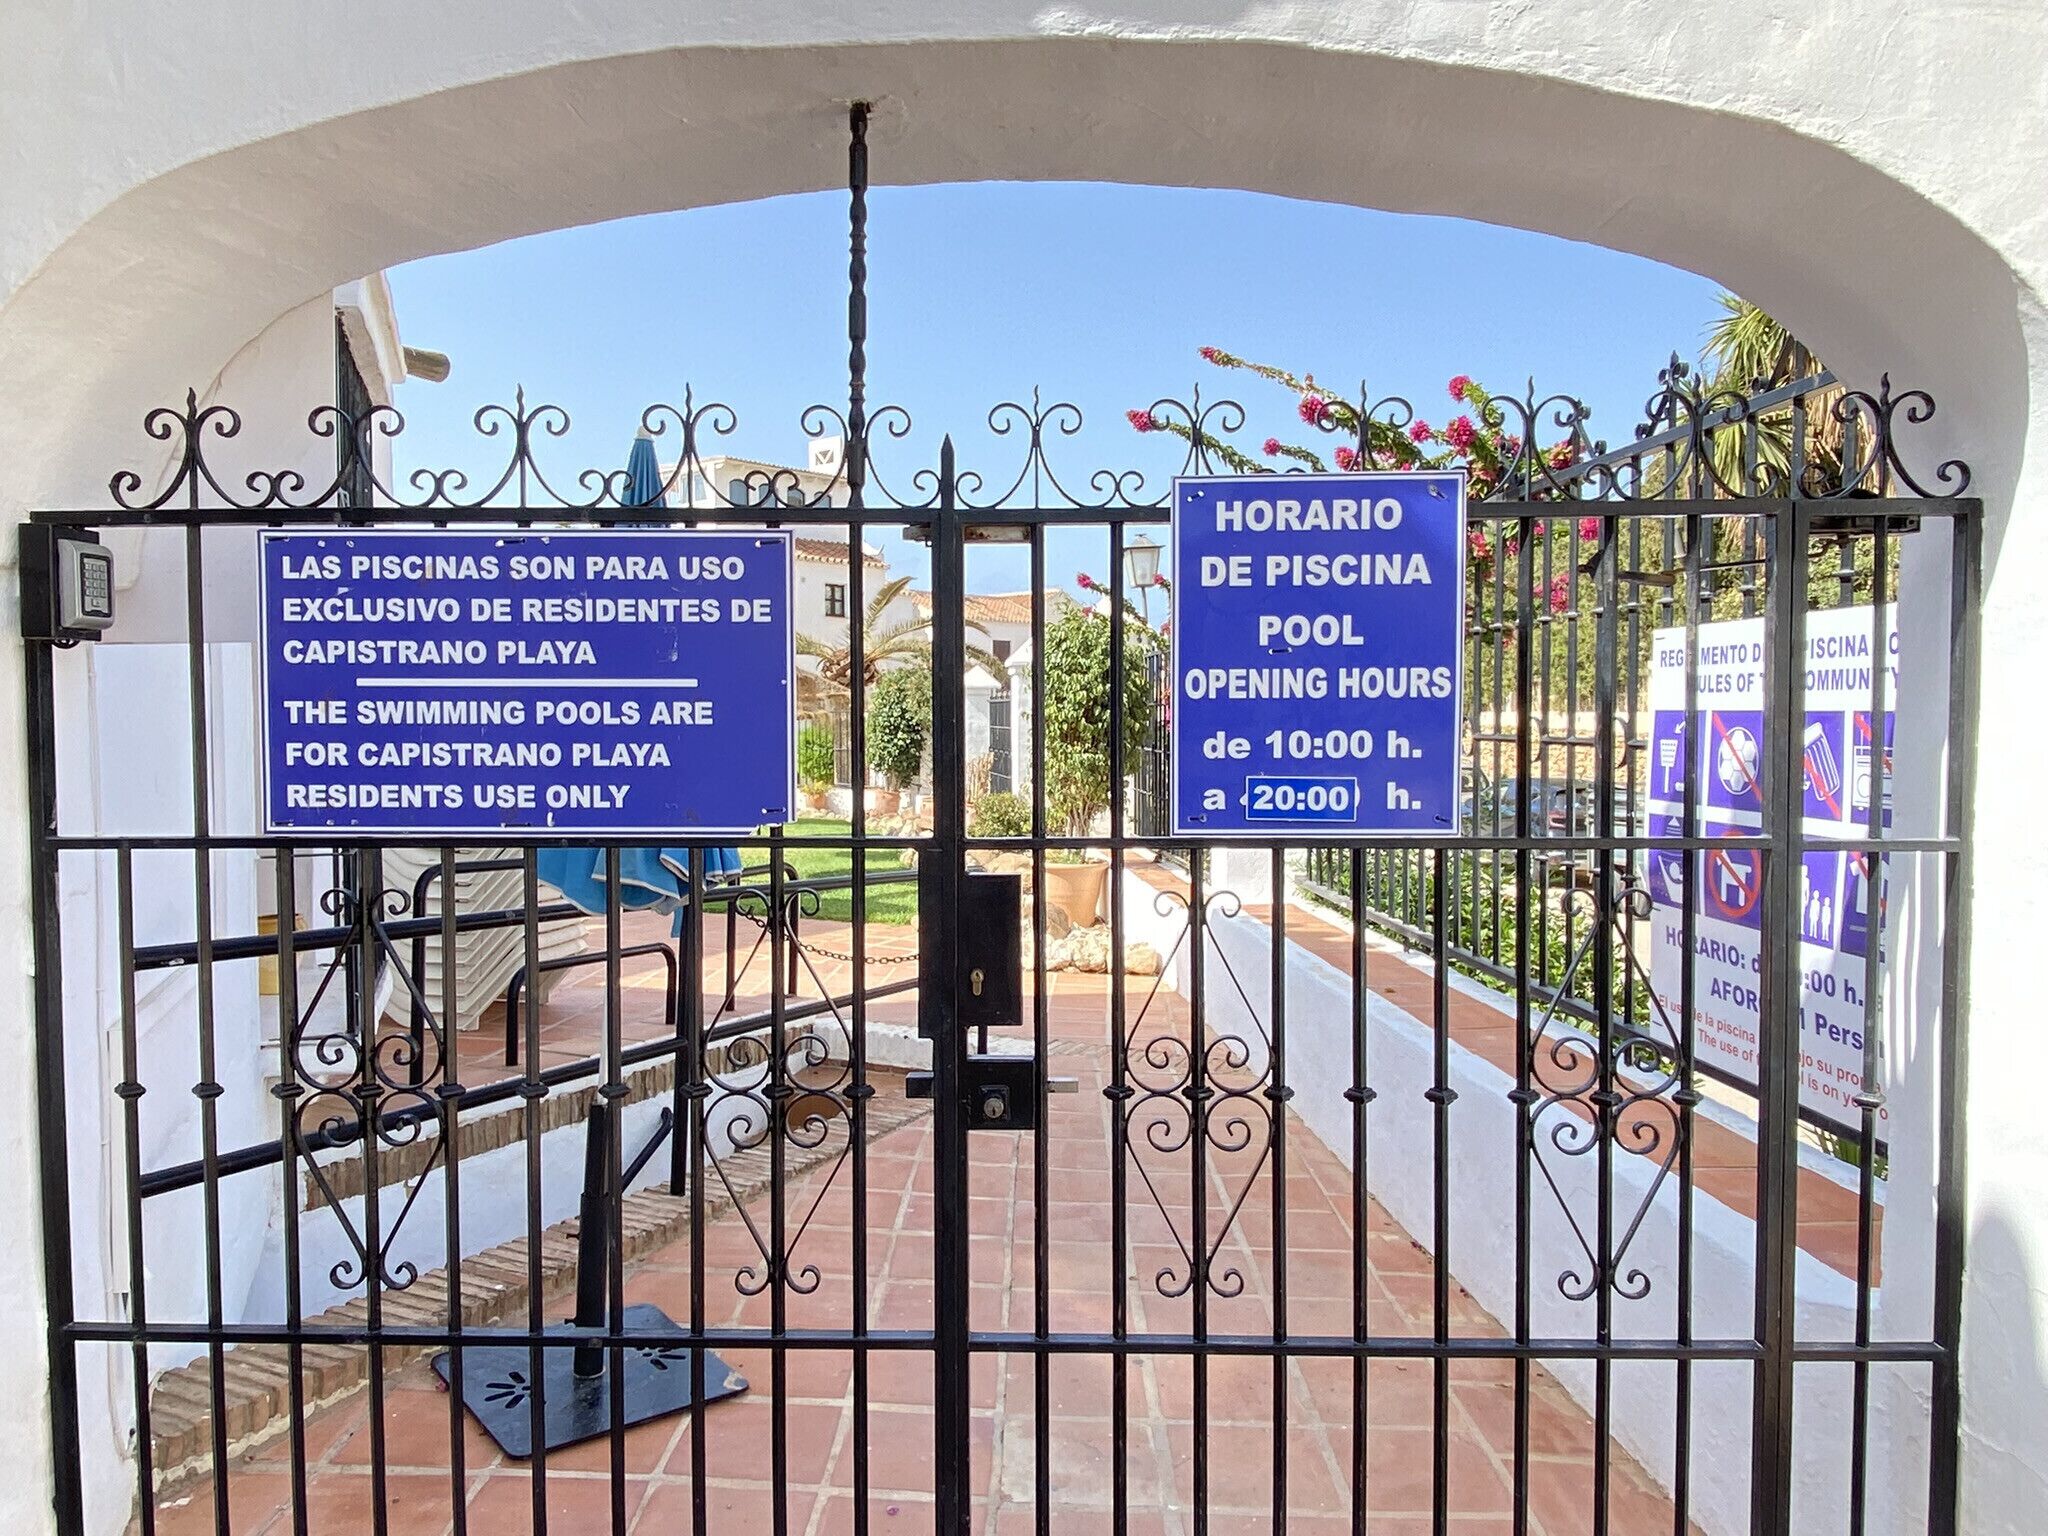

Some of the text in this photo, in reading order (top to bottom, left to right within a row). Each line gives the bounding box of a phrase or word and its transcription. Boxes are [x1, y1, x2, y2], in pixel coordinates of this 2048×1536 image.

[1216, 498, 1403, 532] HORARIO
[282, 555, 745, 581] LAS PISCINAS SON PARA USO
[1201, 553, 1432, 587] DE PISCINA
[283, 597, 772, 622] EXCLUSIVO DE RESIDENTES DE
[1259, 614, 1363, 646] POOL
[283, 639, 596, 665] CAPISTRANO PLAYA
[1660, 644, 1747, 668] REGMENTO
[1752, 642, 1761, 663] D
[1809, 634, 1869, 659] ISCINA
[1184, 667, 1452, 700] OPENING HOURS
[1698, 674, 1732, 693] ULES
[1737, 673, 1755, 693] OF
[283, 700, 714, 725] THE SWIMMING POOLS ARE
[285, 742, 671, 767] FOR CAPISTRANO PLAYA
[1203, 729, 1423, 760] de 10:00 h.
[286, 784, 631, 809] RESIDENTS USE ONLY
[1203, 782, 1422, 811] a 20:00 h.
[1666, 925, 1745, 969] HARIO:
[1844, 978, 1864, 1007] h.
[1710, 977, 1760, 1013] AFOR
[1670, 1001, 1681, 1014] us
[1717, 1019, 1755, 1045] piscina
[1817, 1059, 1832, 1075] su
[1698, 1028, 1717, 1048] The
[1720, 1042, 1738, 1057] use
[1742, 1049, 1754, 1062] of
[1808, 1073, 1819, 1091] is
[1822, 1084, 1839, 1100] on
